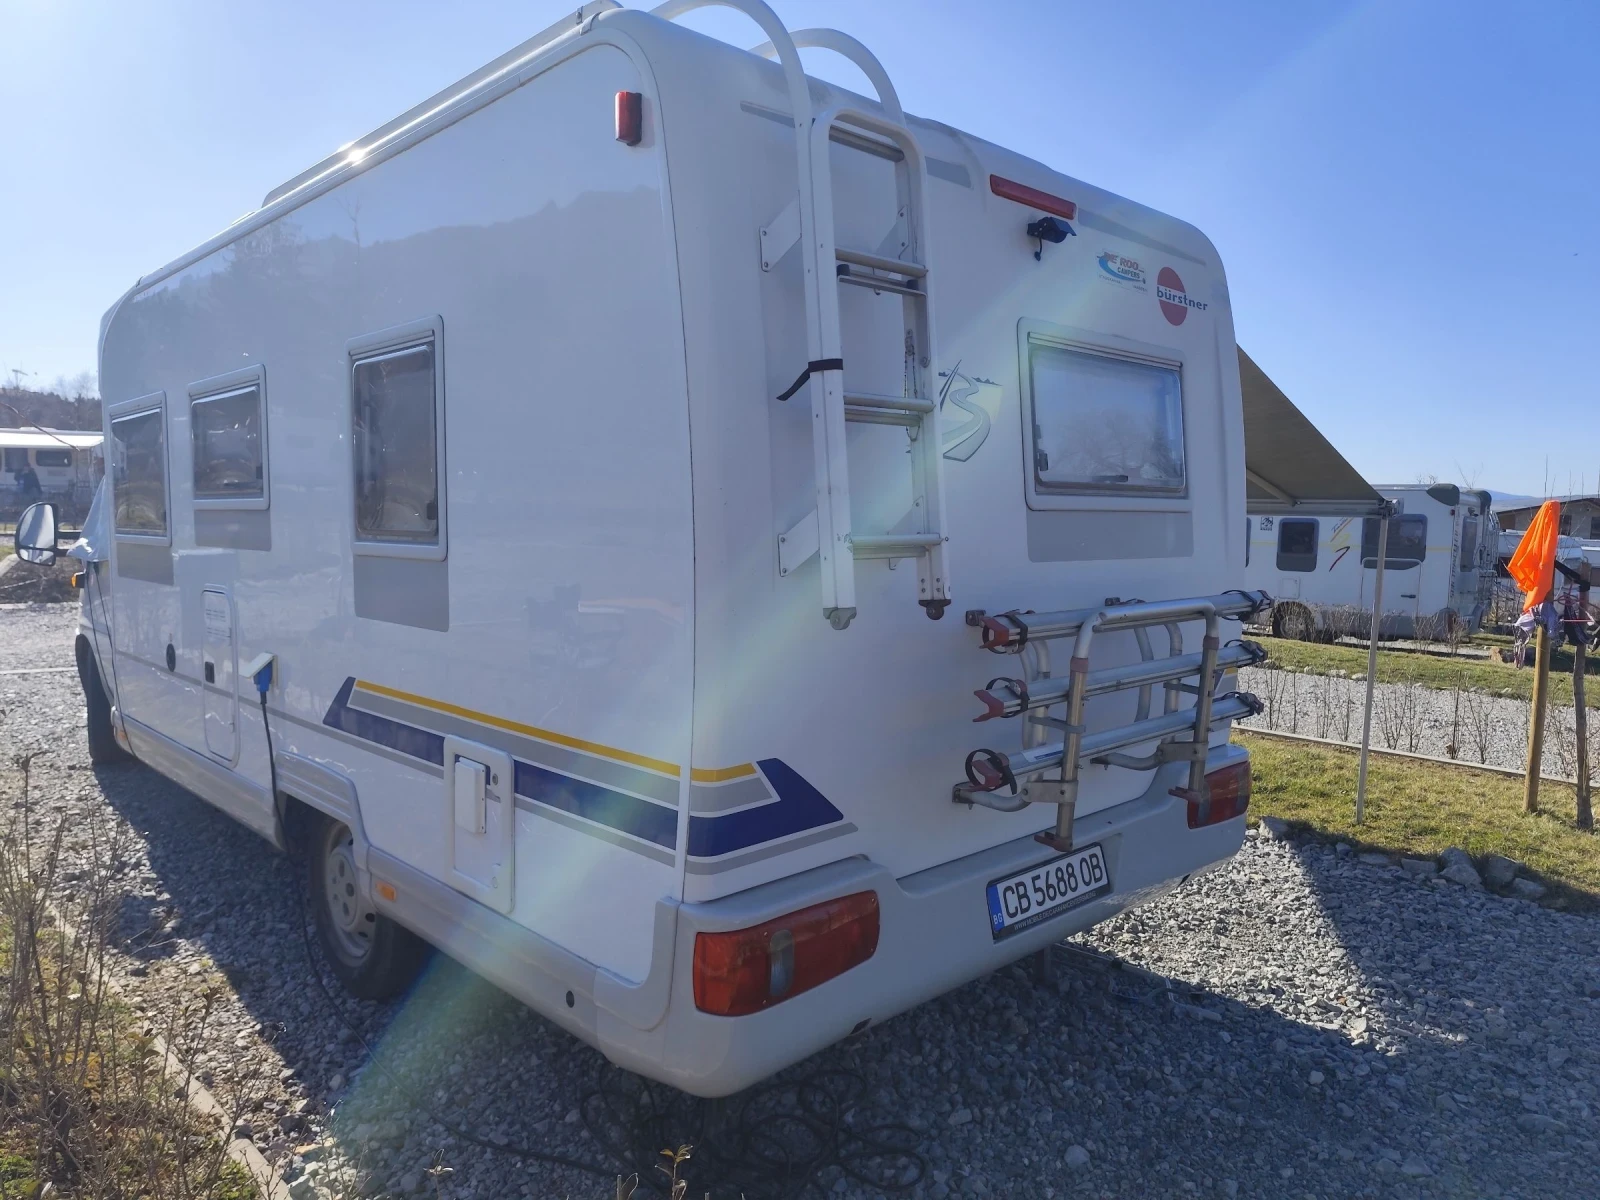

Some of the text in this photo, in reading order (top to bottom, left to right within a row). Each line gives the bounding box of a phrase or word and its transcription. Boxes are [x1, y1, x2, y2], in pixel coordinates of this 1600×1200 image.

[1120, 257, 1139, 270] ROO
[1117, 267, 1140, 279] CAMPERS
[1156, 286, 1208, 311] bürstner
[1002, 852, 1104, 919] CB 5688 OB
[993, 913, 1003, 925] BG
